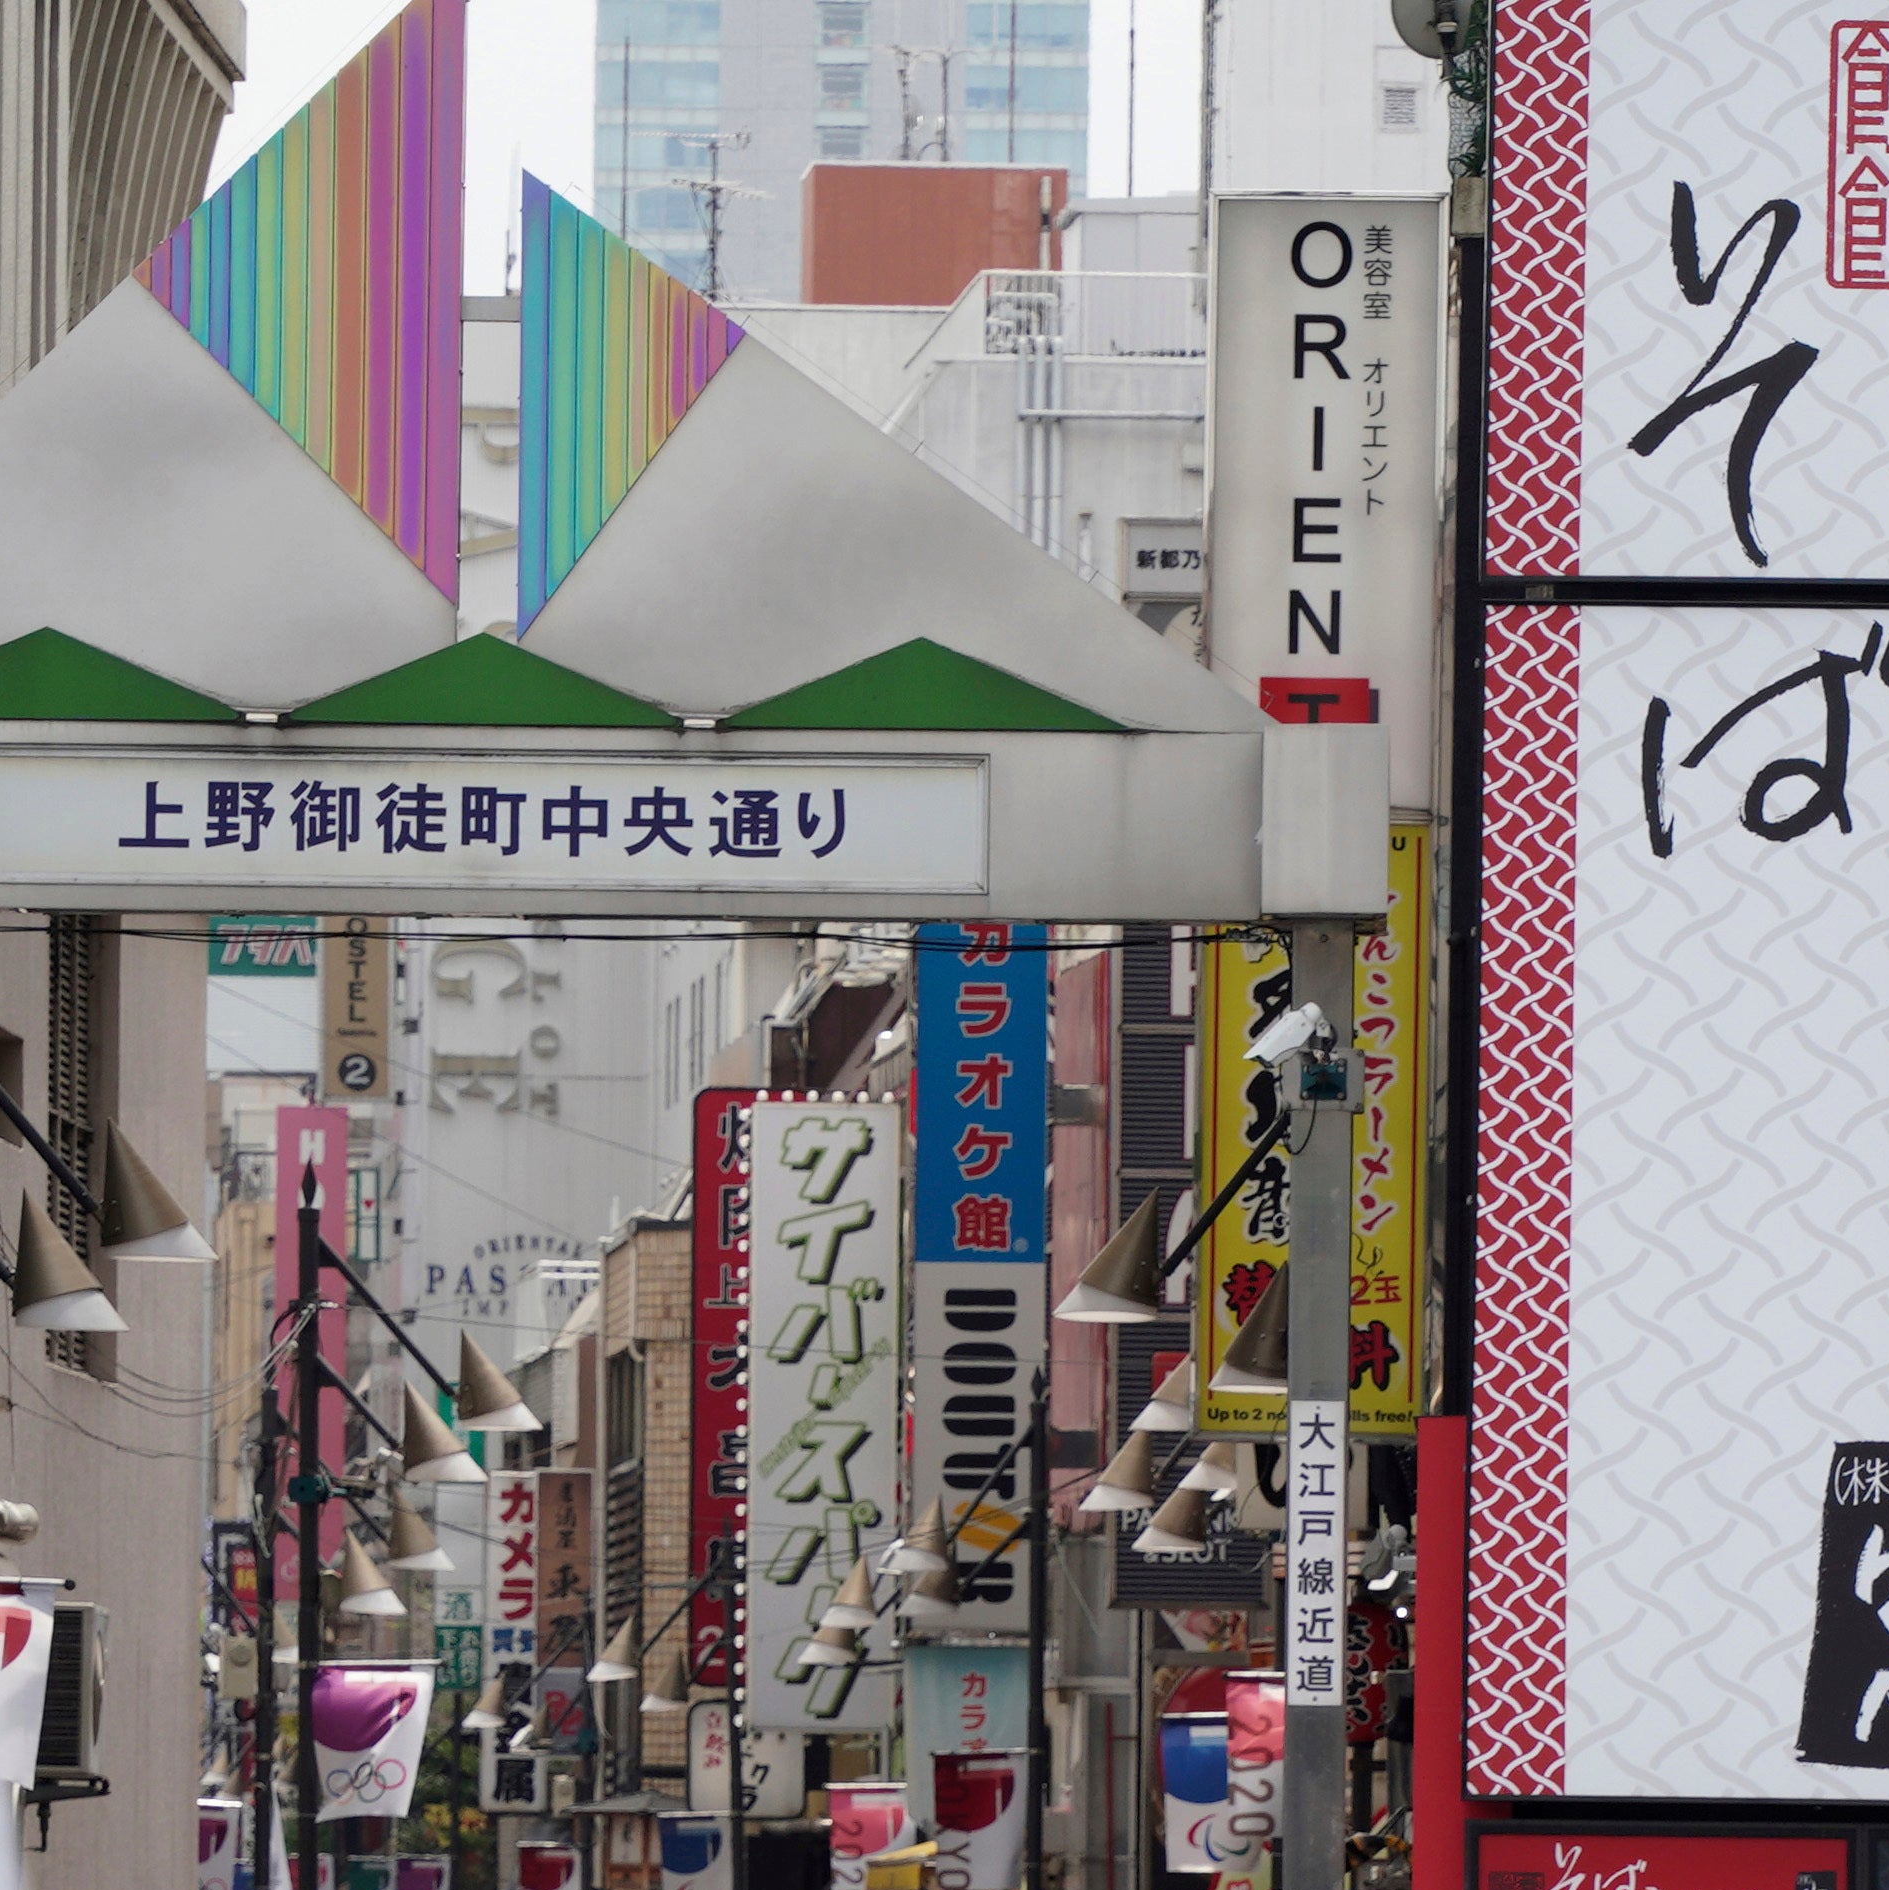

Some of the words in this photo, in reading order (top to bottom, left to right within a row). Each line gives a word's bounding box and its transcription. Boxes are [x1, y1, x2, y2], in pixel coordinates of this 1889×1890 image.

[1362, 224, 1393, 320] 美容室
[1360, 357, 1390, 516] オリエント
[117, 777, 851, 860] 上野御徒町中央通り
[343, 1055, 370, 1087] 2
[953, 922, 1012, 1251] カラオケ館
[1359, 897, 1396, 1232] んこつラーメン
[1206, 1408, 1230, 1422] Up
[1234, 1408, 1248, 1421] to
[1252, 1408, 1263, 1421] 2
[499, 1482, 534, 1620] カメラ
[1295, 1411, 1337, 1693] 大江戸線近道
